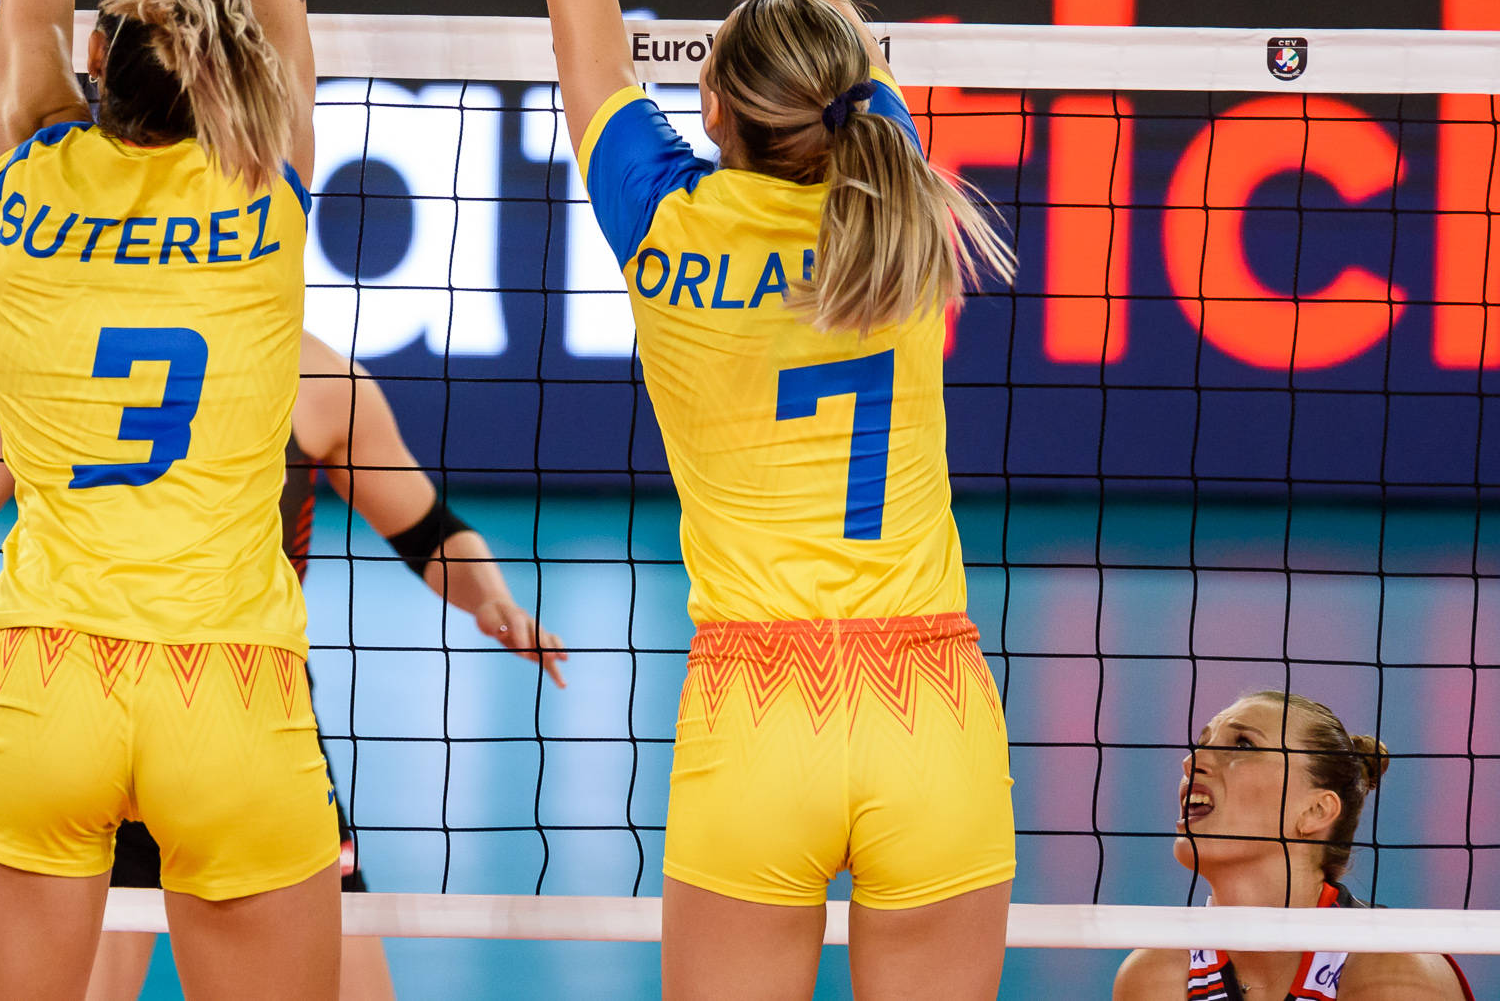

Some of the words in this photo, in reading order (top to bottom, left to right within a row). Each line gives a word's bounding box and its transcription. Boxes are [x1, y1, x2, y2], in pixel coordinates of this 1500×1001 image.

[631, 32, 714, 62] Euro
[635, 247, 816, 309] ORLA
[68, 326, 210, 489] 3
[775, 348, 895, 541] 7
